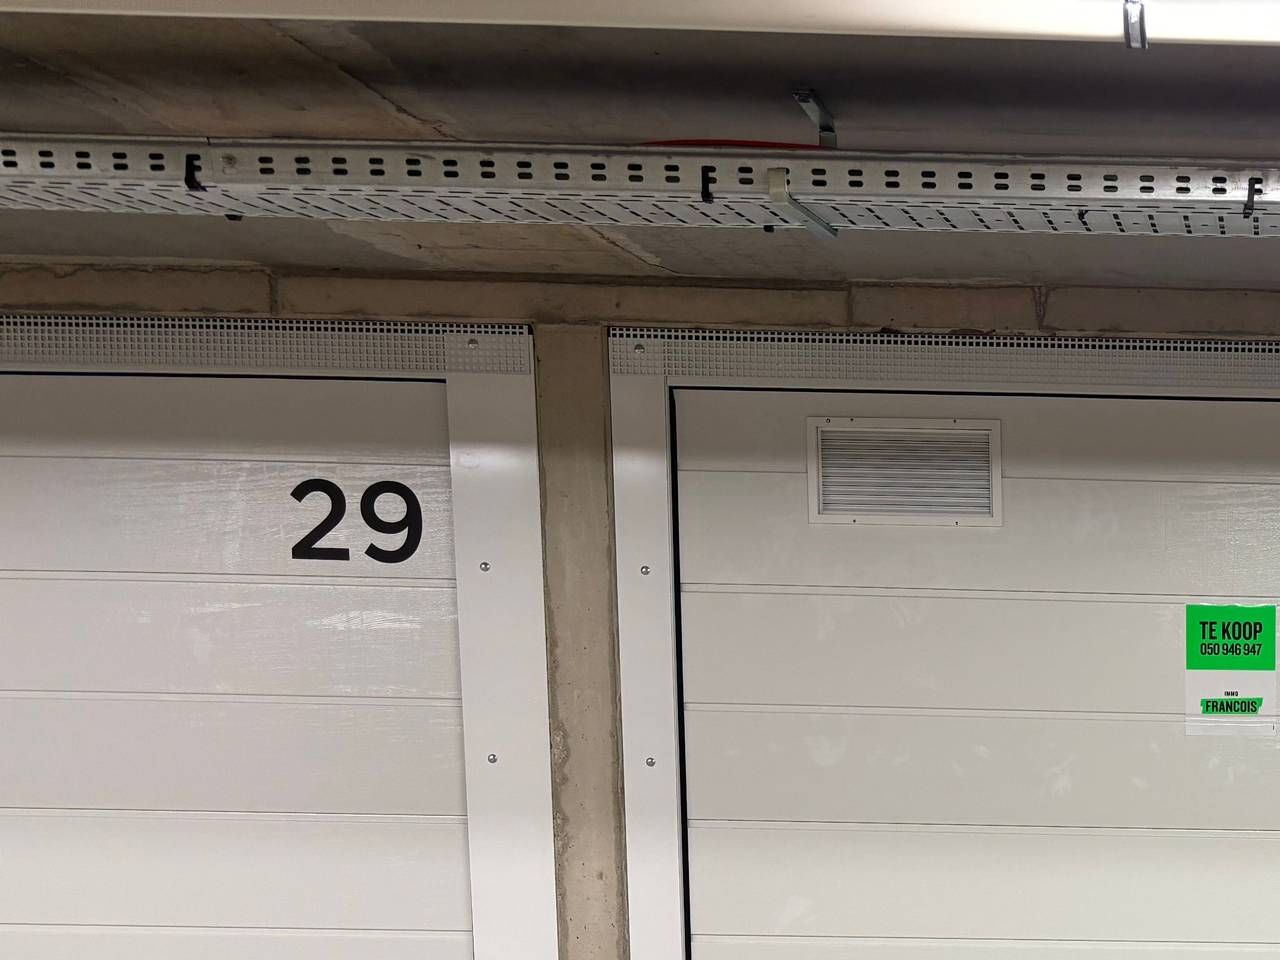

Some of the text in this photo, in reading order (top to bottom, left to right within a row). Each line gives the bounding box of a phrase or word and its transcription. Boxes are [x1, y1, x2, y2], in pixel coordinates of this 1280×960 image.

[290, 478, 423, 563] 29
[1199, 621, 1262, 640] TE KOOP
[1200, 643, 1262, 656] 050 946 947
[1205, 700, 1257, 713] FRANCOIS
